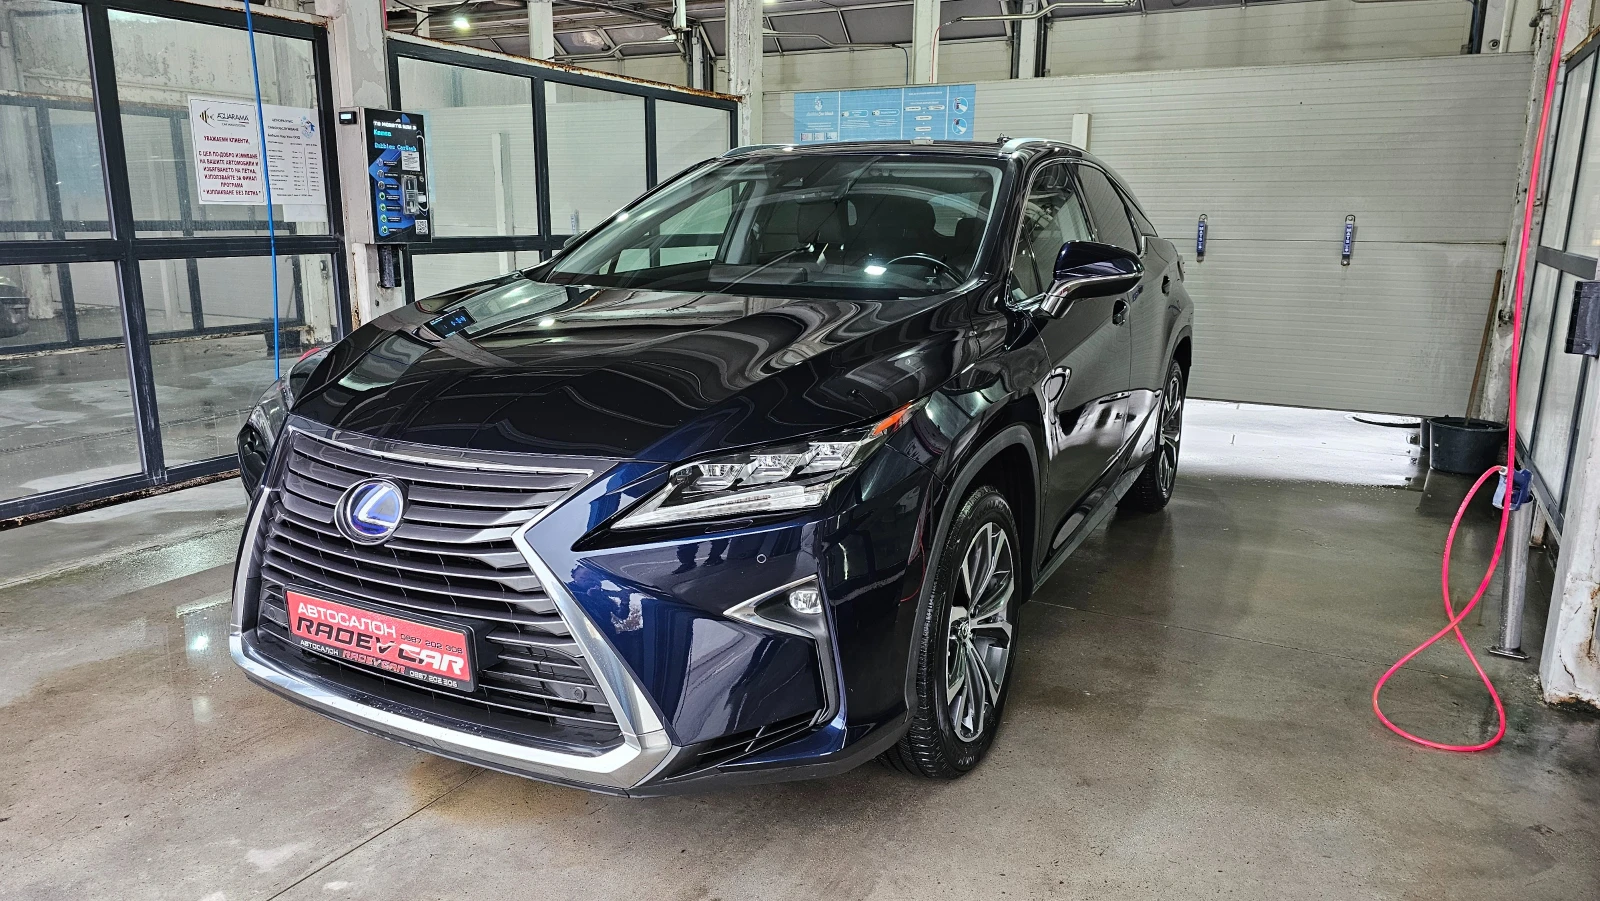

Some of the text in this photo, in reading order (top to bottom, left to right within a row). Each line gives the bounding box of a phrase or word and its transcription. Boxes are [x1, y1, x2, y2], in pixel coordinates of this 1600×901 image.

[217, 113, 249, 121] AQUARAMA
[203, 135, 228, 143] УВАЖАЕМИ
[298, 603, 396, 637] АВТОСАЛОН
[301, 640, 338, 656] АВТОСАЛОН
[400, 634, 421, 644] 0887
[425, 640, 443, 650] 202
[409, 670, 427, 680] 0887
[428, 675, 443, 684] 202
